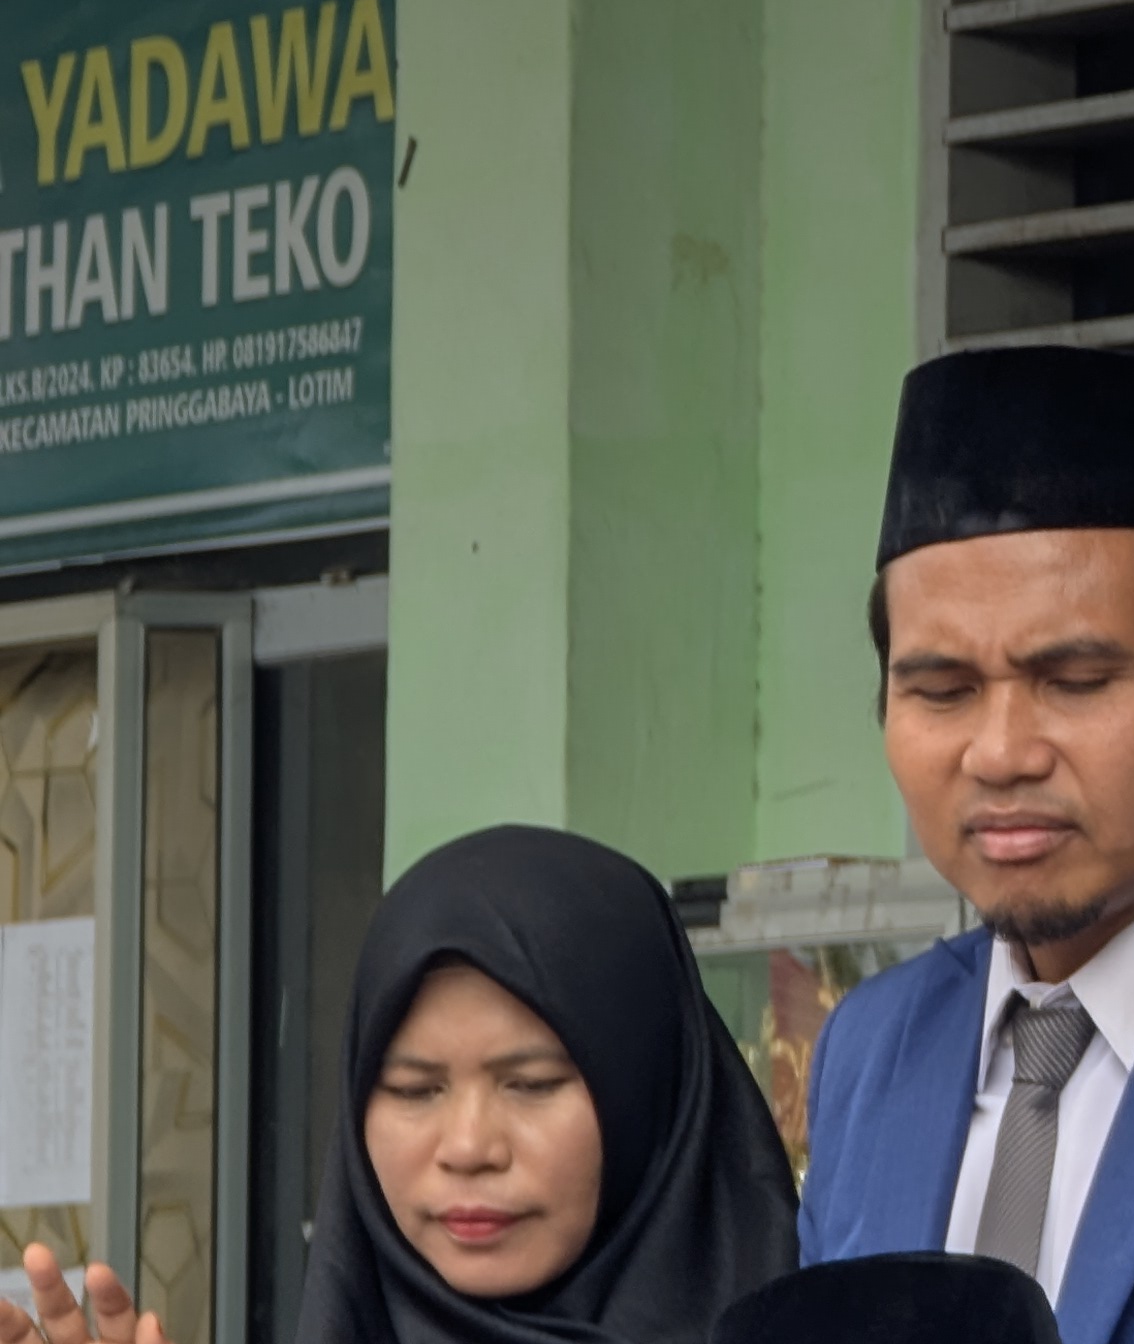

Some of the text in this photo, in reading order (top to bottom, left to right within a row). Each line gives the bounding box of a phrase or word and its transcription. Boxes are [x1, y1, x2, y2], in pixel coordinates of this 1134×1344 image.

[190, 165, 371, 308] TEKO
[0, 404, 120, 453] KECAMATAN
[126, 379, 272, 436] PRINGGABAYA
[288, 365, 354, 411] LOTIM
